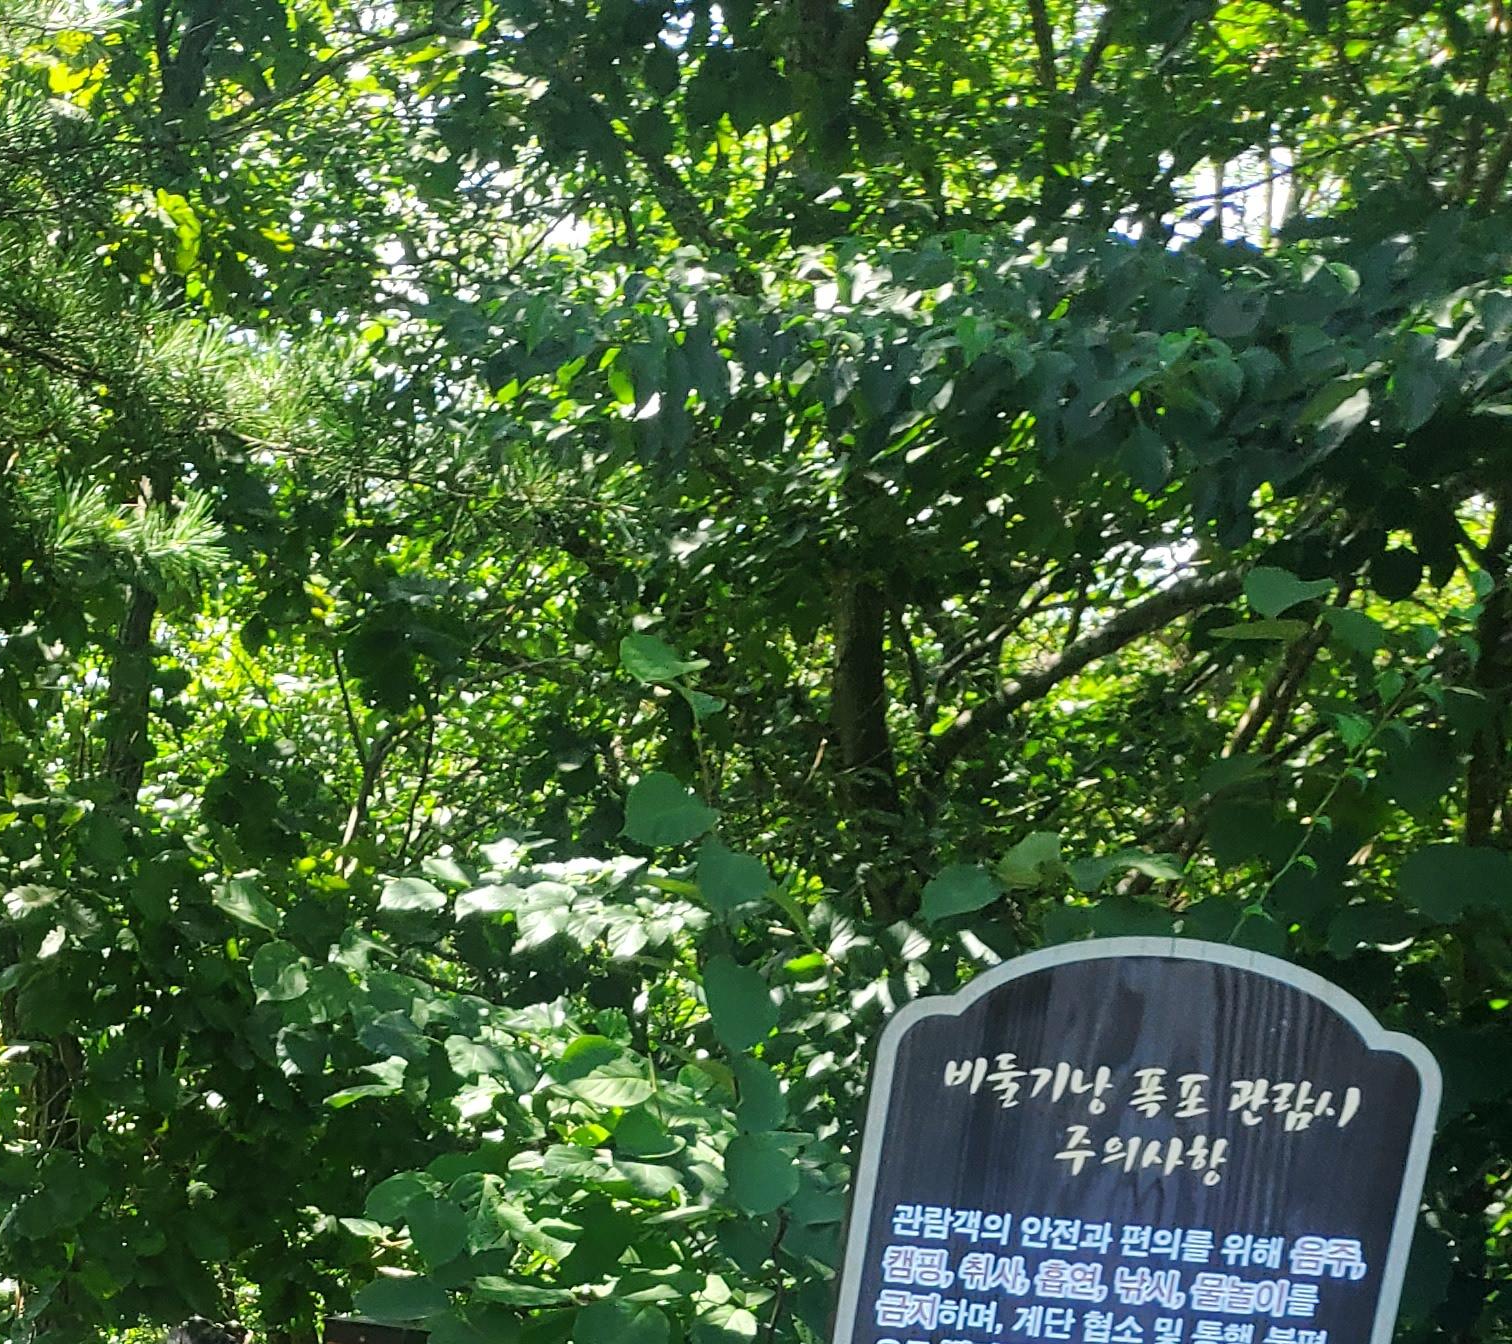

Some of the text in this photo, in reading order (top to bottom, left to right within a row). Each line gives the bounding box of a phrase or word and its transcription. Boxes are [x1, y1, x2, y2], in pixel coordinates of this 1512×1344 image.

[944, 1053, 1361, 1132] 비둘기낭 폭포 관람시
[1055, 1126, 1227, 1186] 주의사항
[892, 1204, 1367, 1280] 관람객의 안전과 편의를 위해 음주,
[875, 1290, 1002, 1334] 금지하며,
[1012, 1303, 1075, 1339] 계단
[1082, 1310, 1143, 1344] 협소
[882, 1246, 1320, 1317] 캠핑, 취사, 흡연, 낚시, 물놀이를
